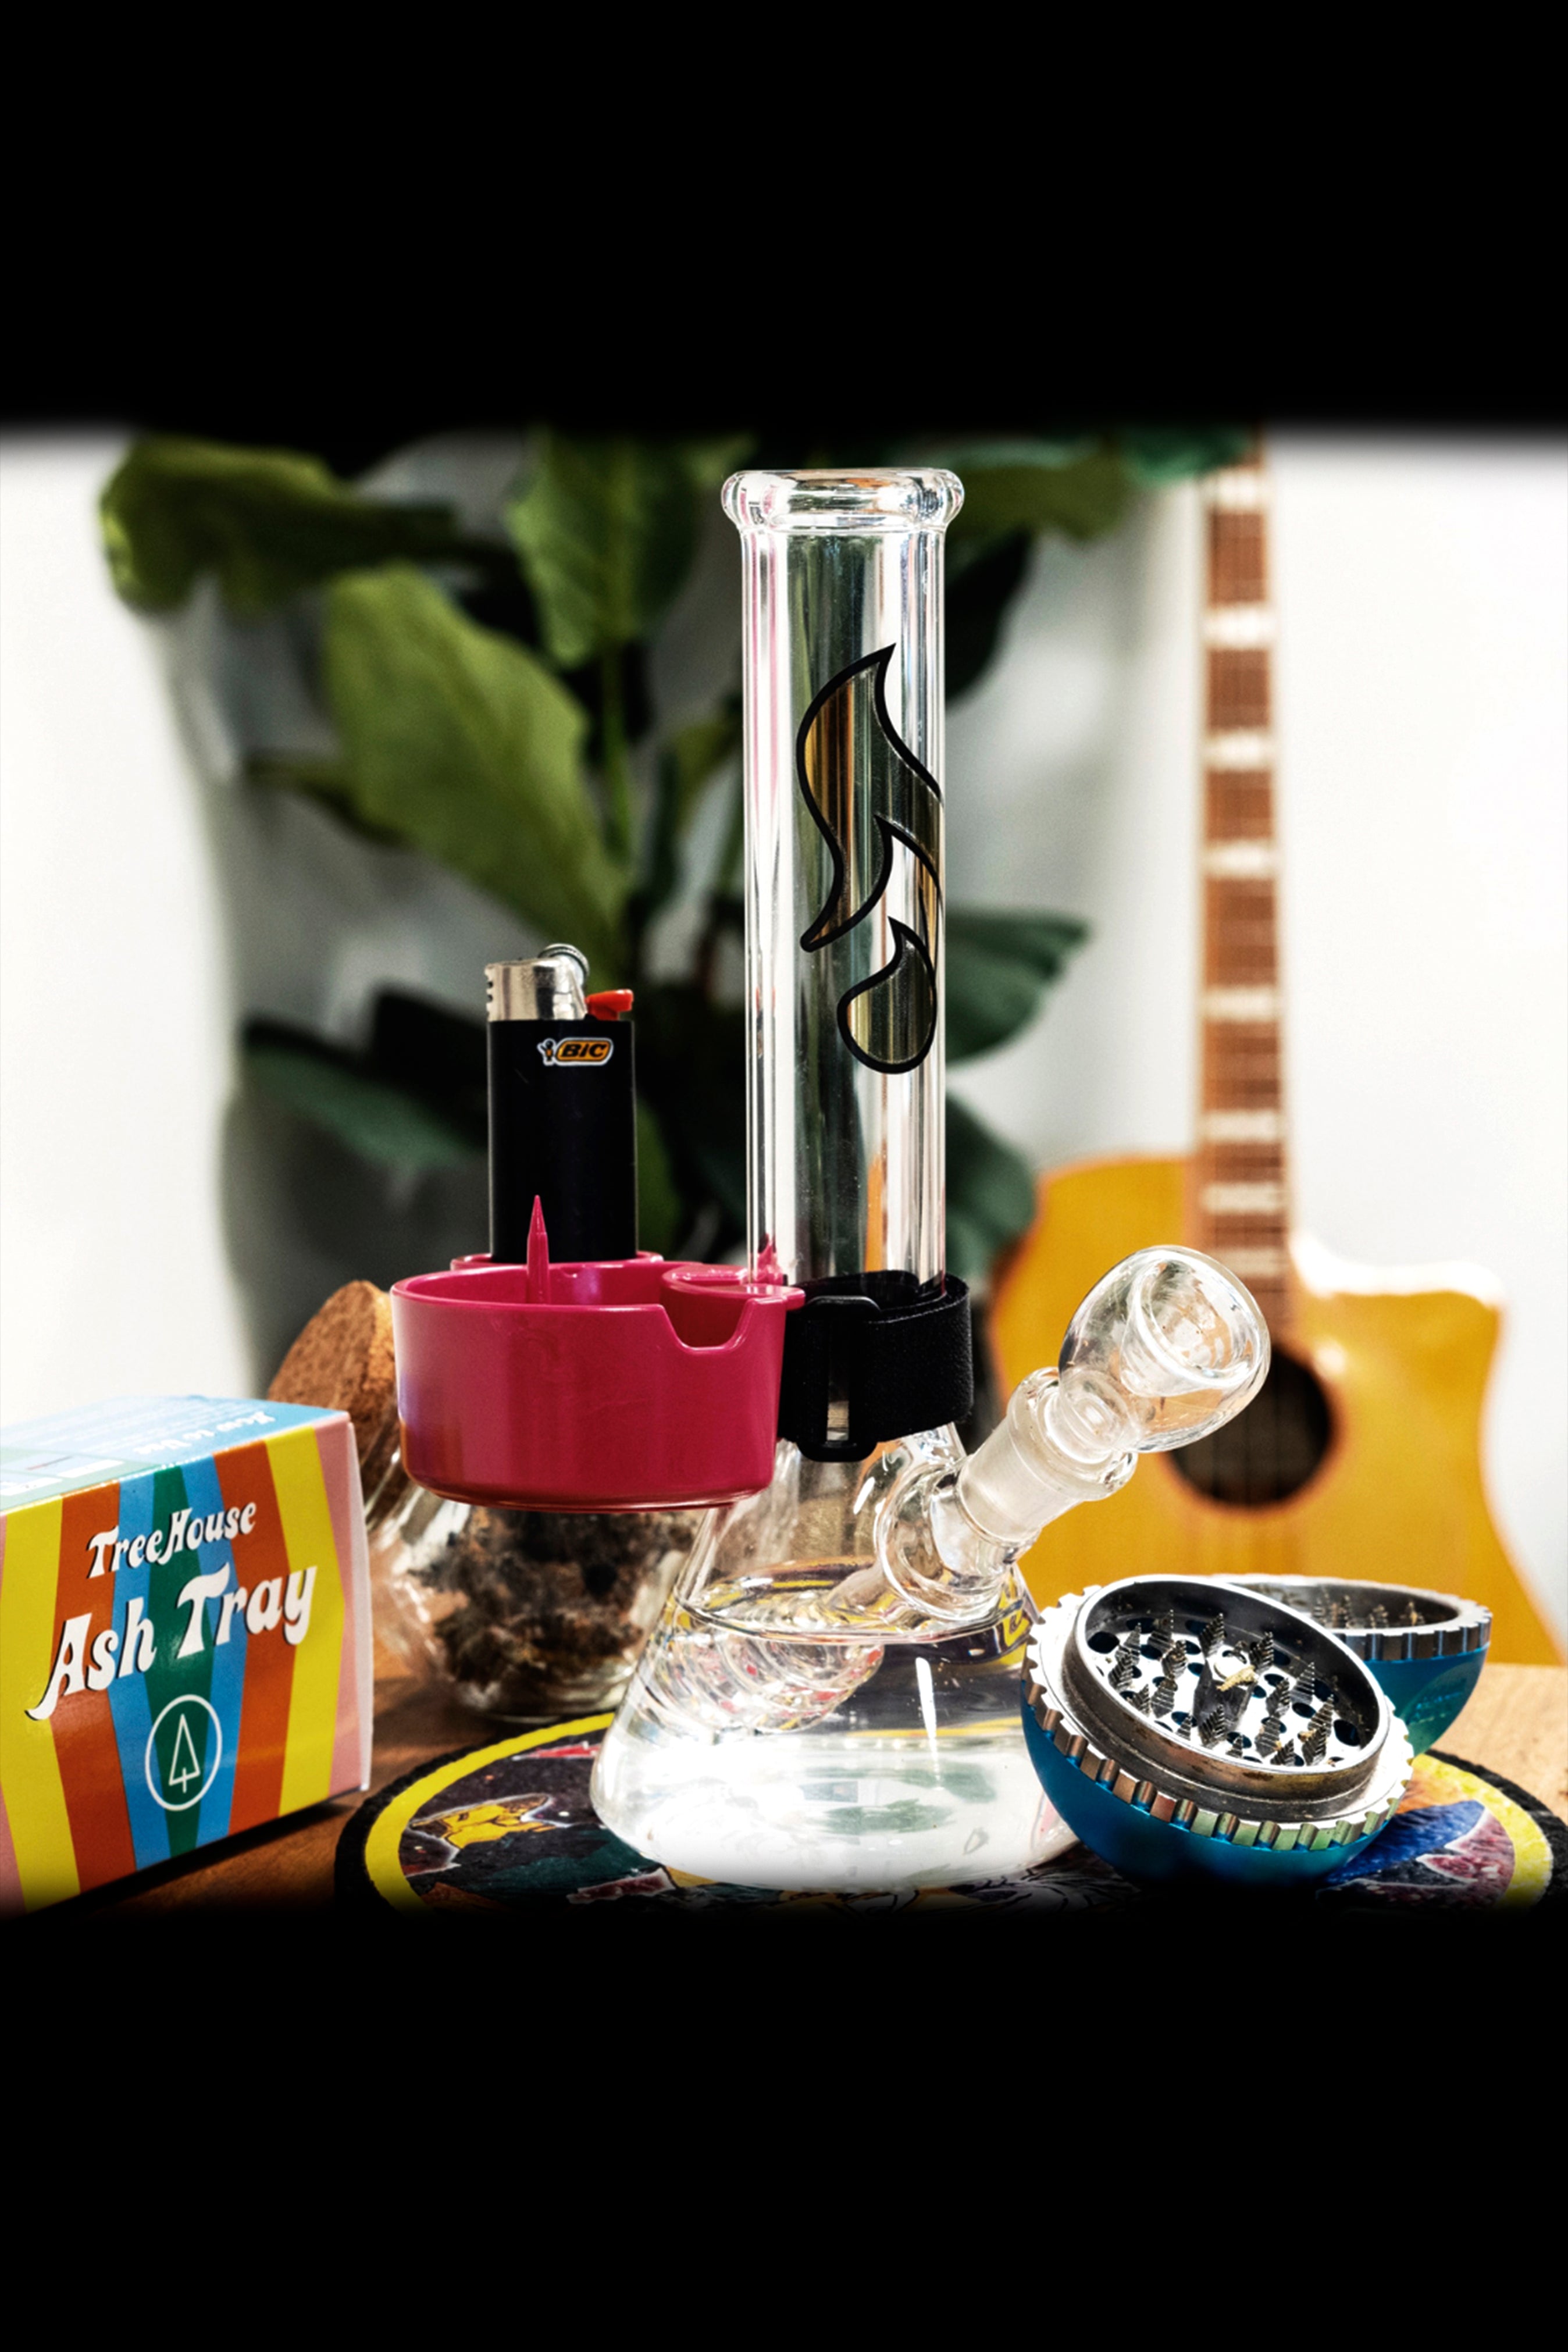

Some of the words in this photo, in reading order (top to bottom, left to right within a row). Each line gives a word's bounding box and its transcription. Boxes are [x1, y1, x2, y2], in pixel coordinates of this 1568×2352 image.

[560, 1043, 608, 1058] BIC
[87, 1502, 256, 1579] TreeHouse
[24, 1596, 157, 1721] Ash
[176, 1562, 318, 1659] Tray
